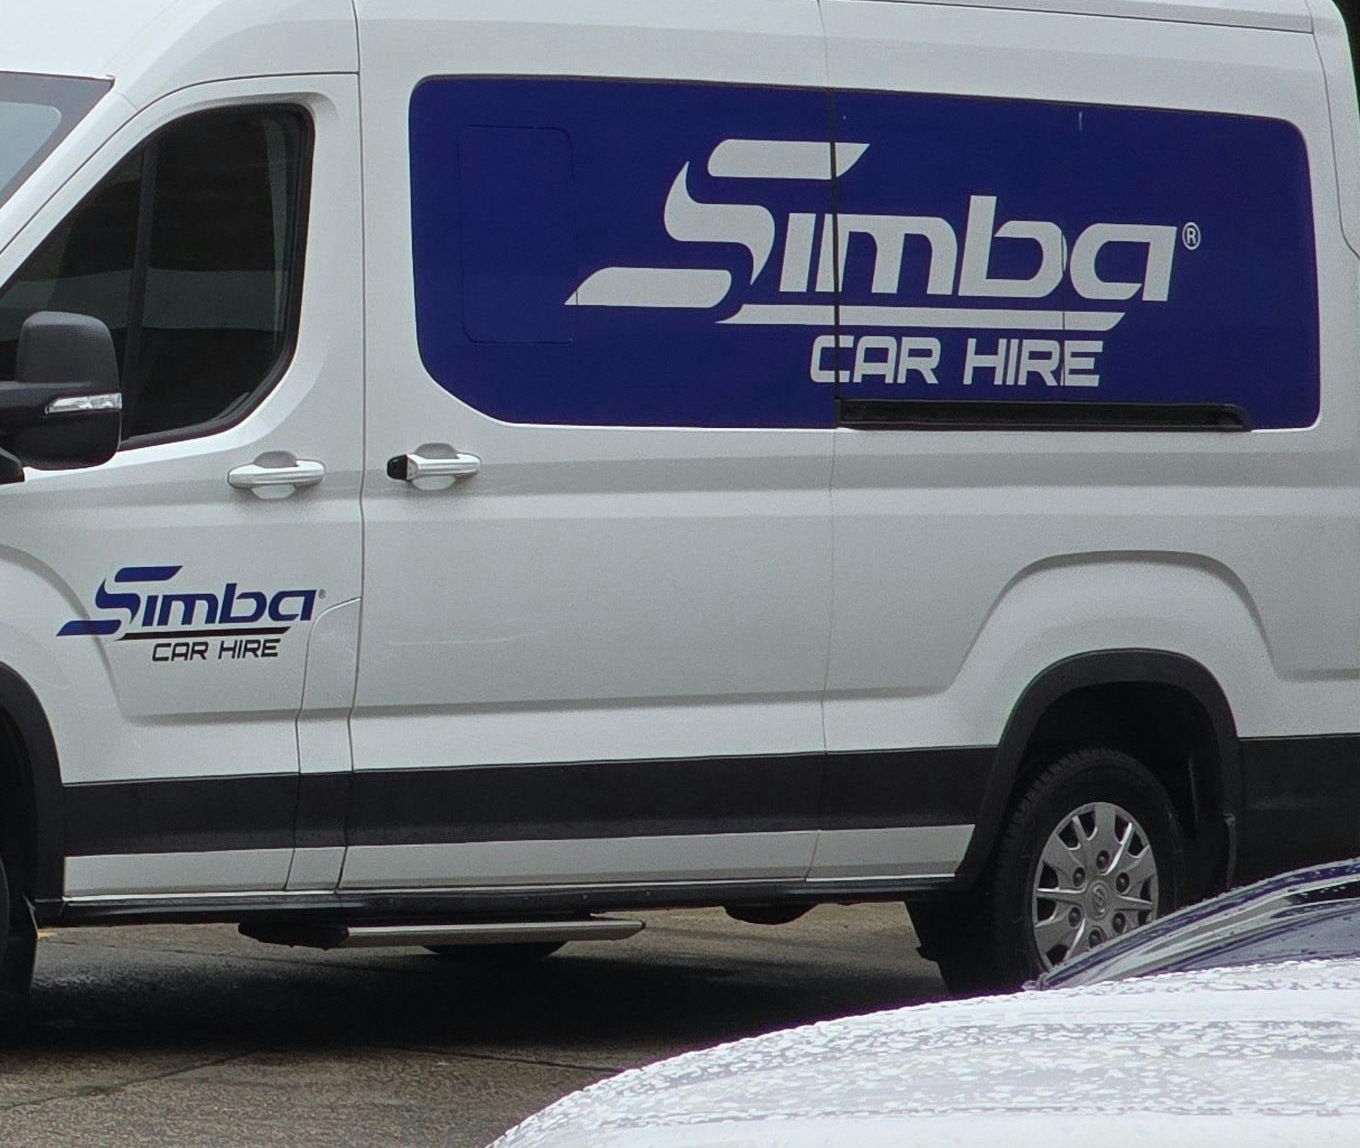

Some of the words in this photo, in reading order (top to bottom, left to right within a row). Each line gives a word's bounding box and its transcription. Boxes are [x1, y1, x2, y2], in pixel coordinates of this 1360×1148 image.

[810, 335, 940, 384] CAR
[963, 338, 1103, 387] HIRE
[152, 643, 207, 662] CAR
[218, 639, 279, 660] HIRE
